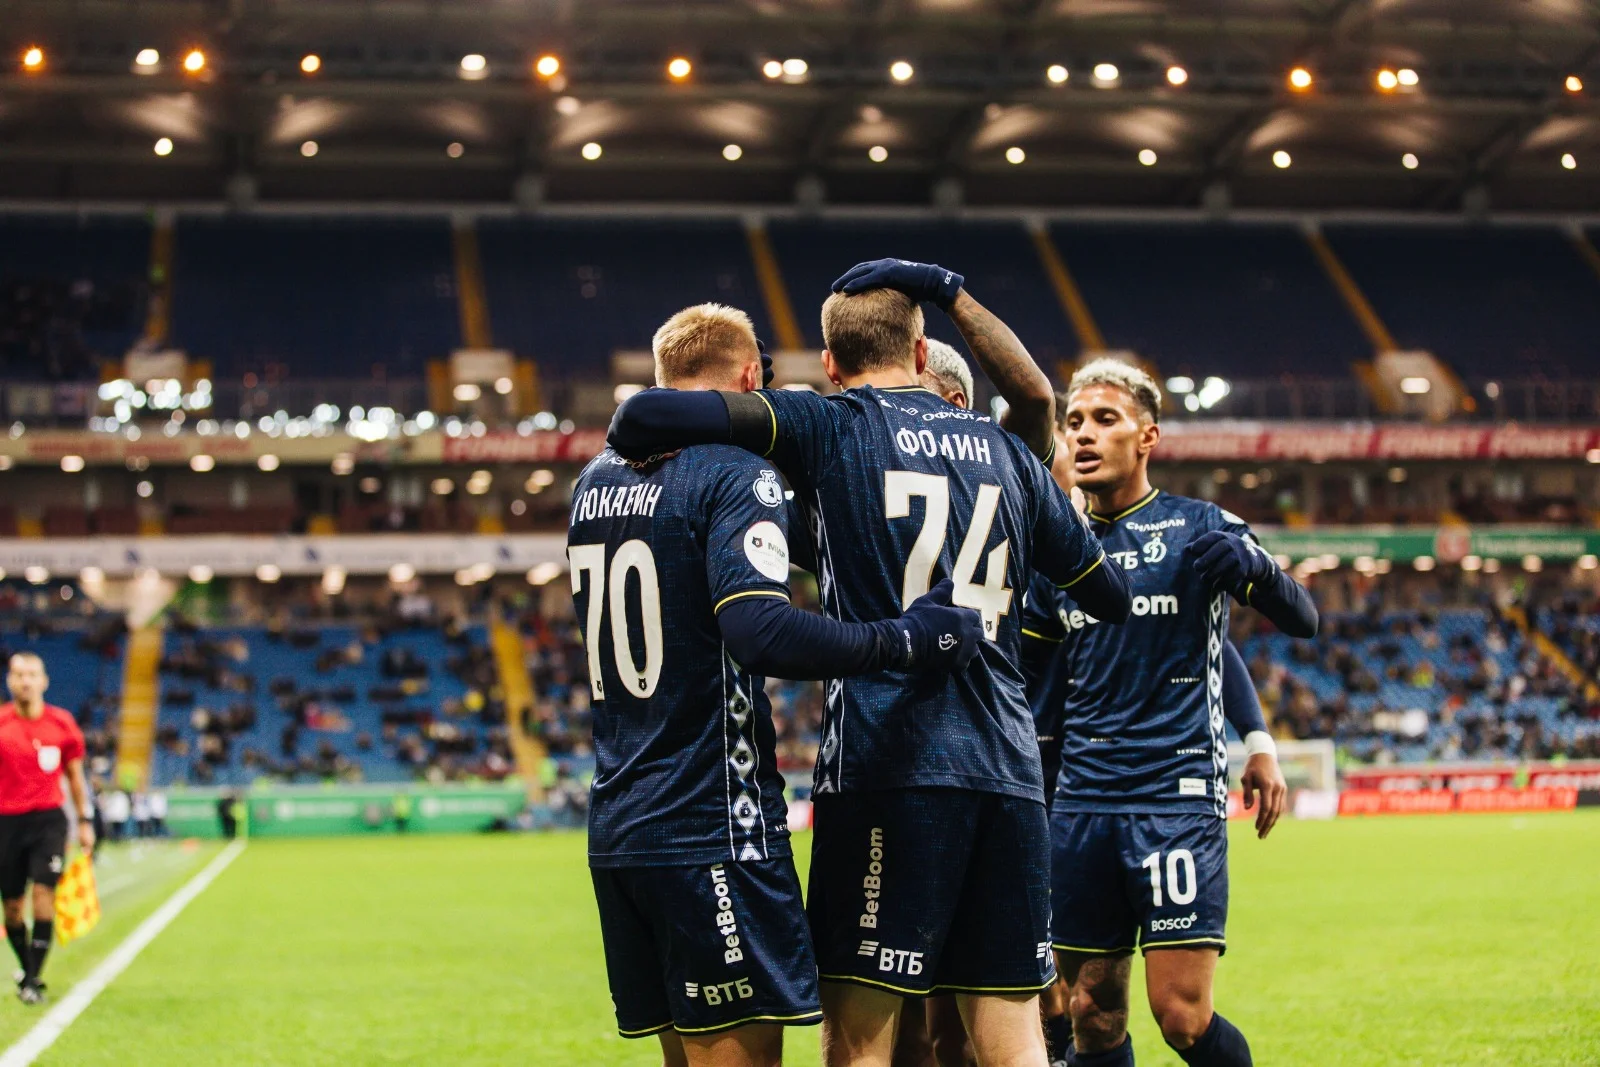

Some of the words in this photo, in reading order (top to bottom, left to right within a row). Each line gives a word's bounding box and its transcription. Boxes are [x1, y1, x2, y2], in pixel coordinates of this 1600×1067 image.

[1125, 518, 1186, 532] CHANGAN
[884, 470, 1013, 642] 74
[1110, 551, 1139, 570] ТБ
[567, 539, 664, 700] 70
[860, 827, 883, 929] BetBoom
[1142, 849, 1198, 907] 10
[710, 863, 744, 965] BetBoom
[1151, 916, 1192, 932] BOSCO
[879, 947, 924, 975] ВТБ
[702, 977, 754, 1006] ВТБ
